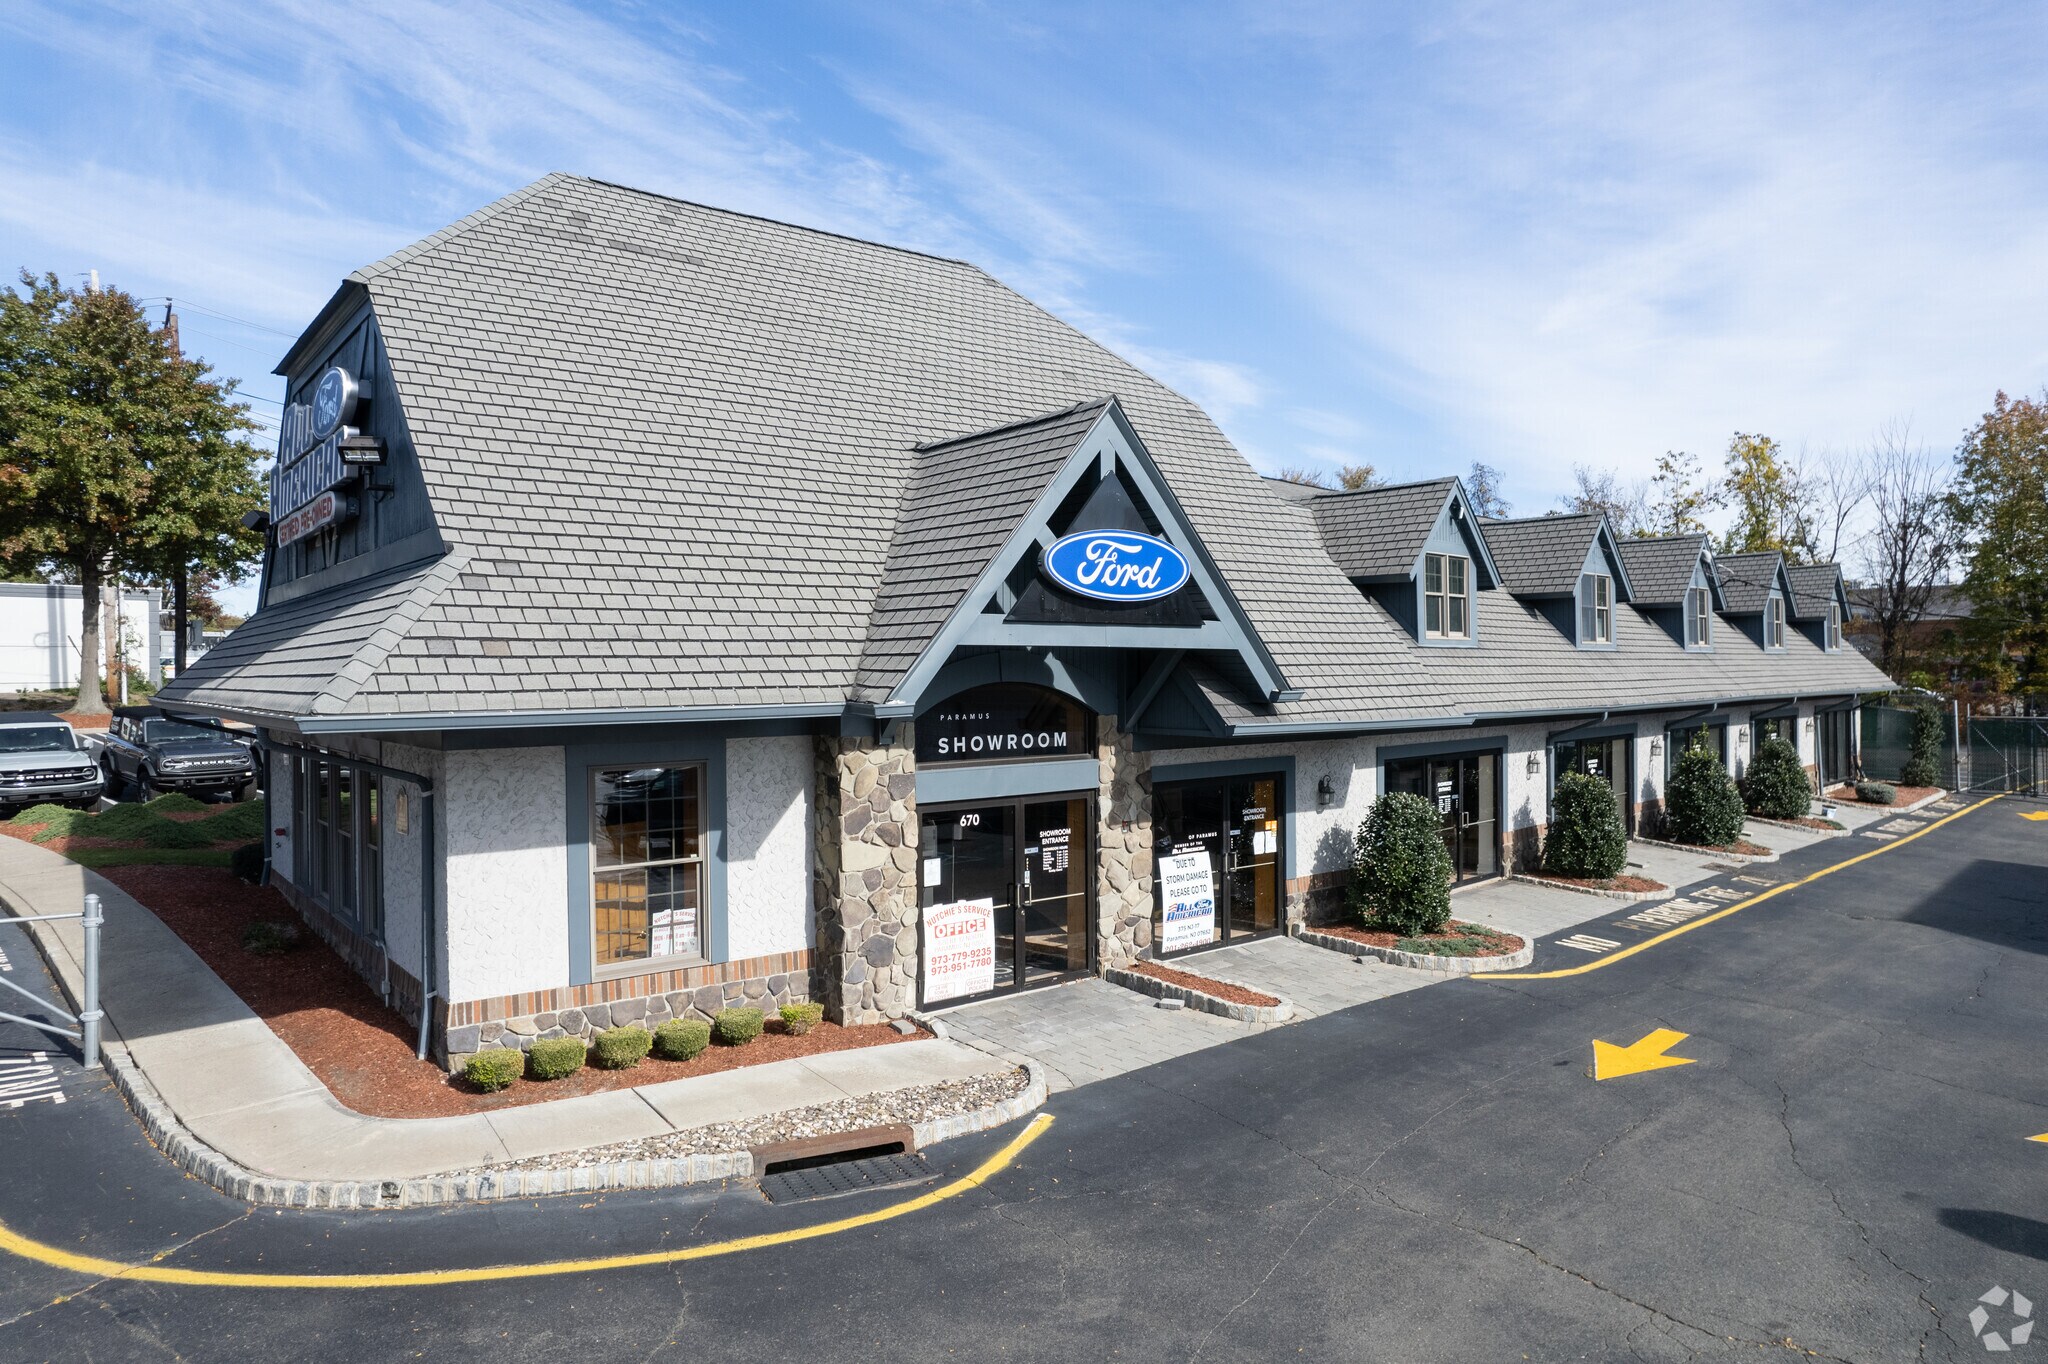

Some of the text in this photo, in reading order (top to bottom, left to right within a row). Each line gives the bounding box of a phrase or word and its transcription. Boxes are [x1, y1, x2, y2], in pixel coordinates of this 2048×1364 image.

[1076, 539, 1163, 589] Ford
[940, 712, 990, 721] PARAMUS
[938, 731, 1067, 754] SHOWROOM
[960, 813, 980, 827] 670
[1039, 828, 1072, 838] SHOWROOM
[1042, 836, 1069, 845] ENTRANCE
[1176, 857, 1196, 869] DUE TO
[1166, 870, 1209, 885] STORM DAMAGE
[1170, 884, 1208, 898] PLEASE GO TO
[927, 905, 992, 928] NUTCHIE'S SERVICE
[935, 919, 986, 938] OFFICE
[931, 947, 992, 966] 973-779-9235
[931, 956, 992, 976] 973-951-7780
[966, 979, 989, 987] OFFICIAL
